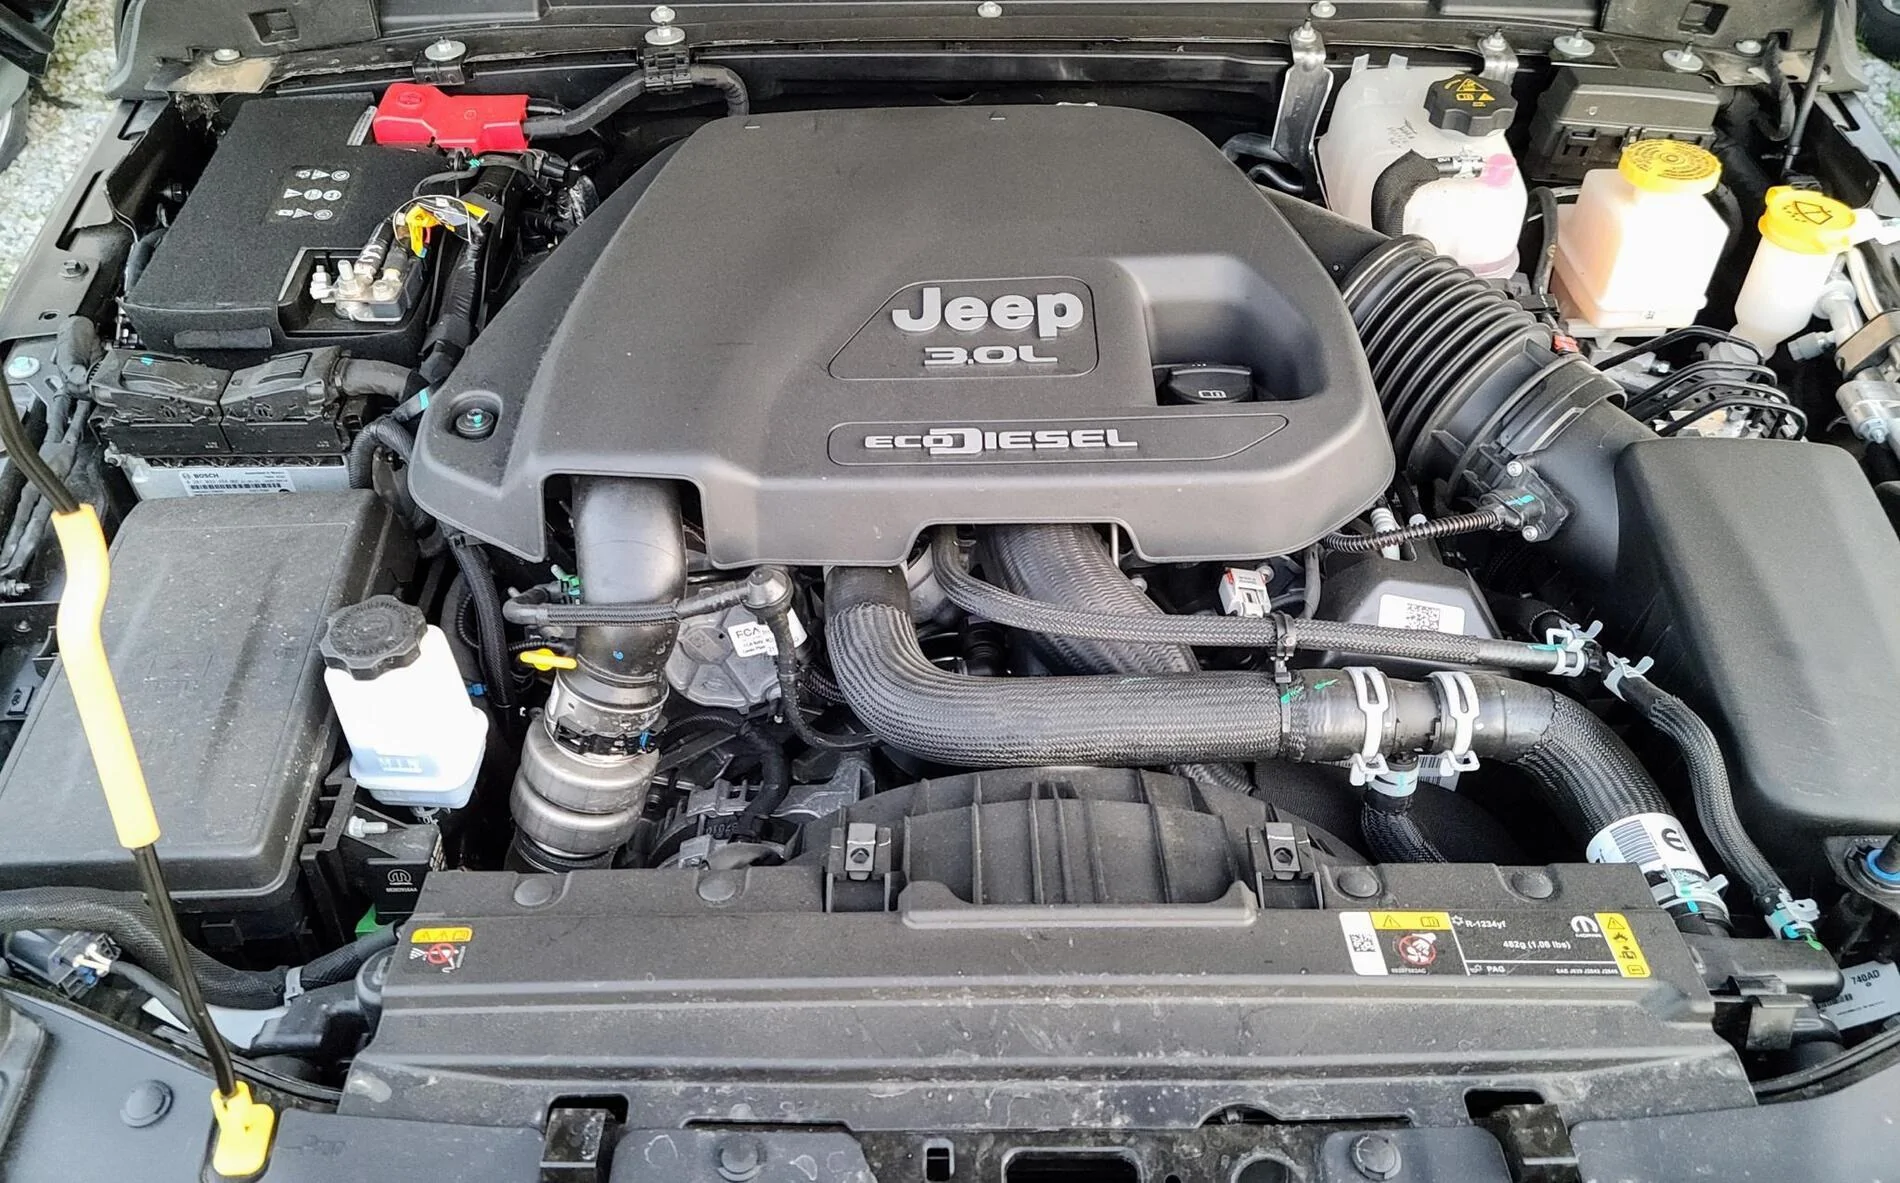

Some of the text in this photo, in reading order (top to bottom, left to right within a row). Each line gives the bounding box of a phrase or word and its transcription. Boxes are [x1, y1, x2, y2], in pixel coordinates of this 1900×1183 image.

[892, 287, 1084, 338] Jeep
[924, 345, 1058, 366] 3.0L
[736, 627, 760, 639] FCA
[1465, 921, 1506, 929] R-1234yf
[1552, 941, 1571, 949] lbs)
[1486, 965, 1506, 973] PAG
